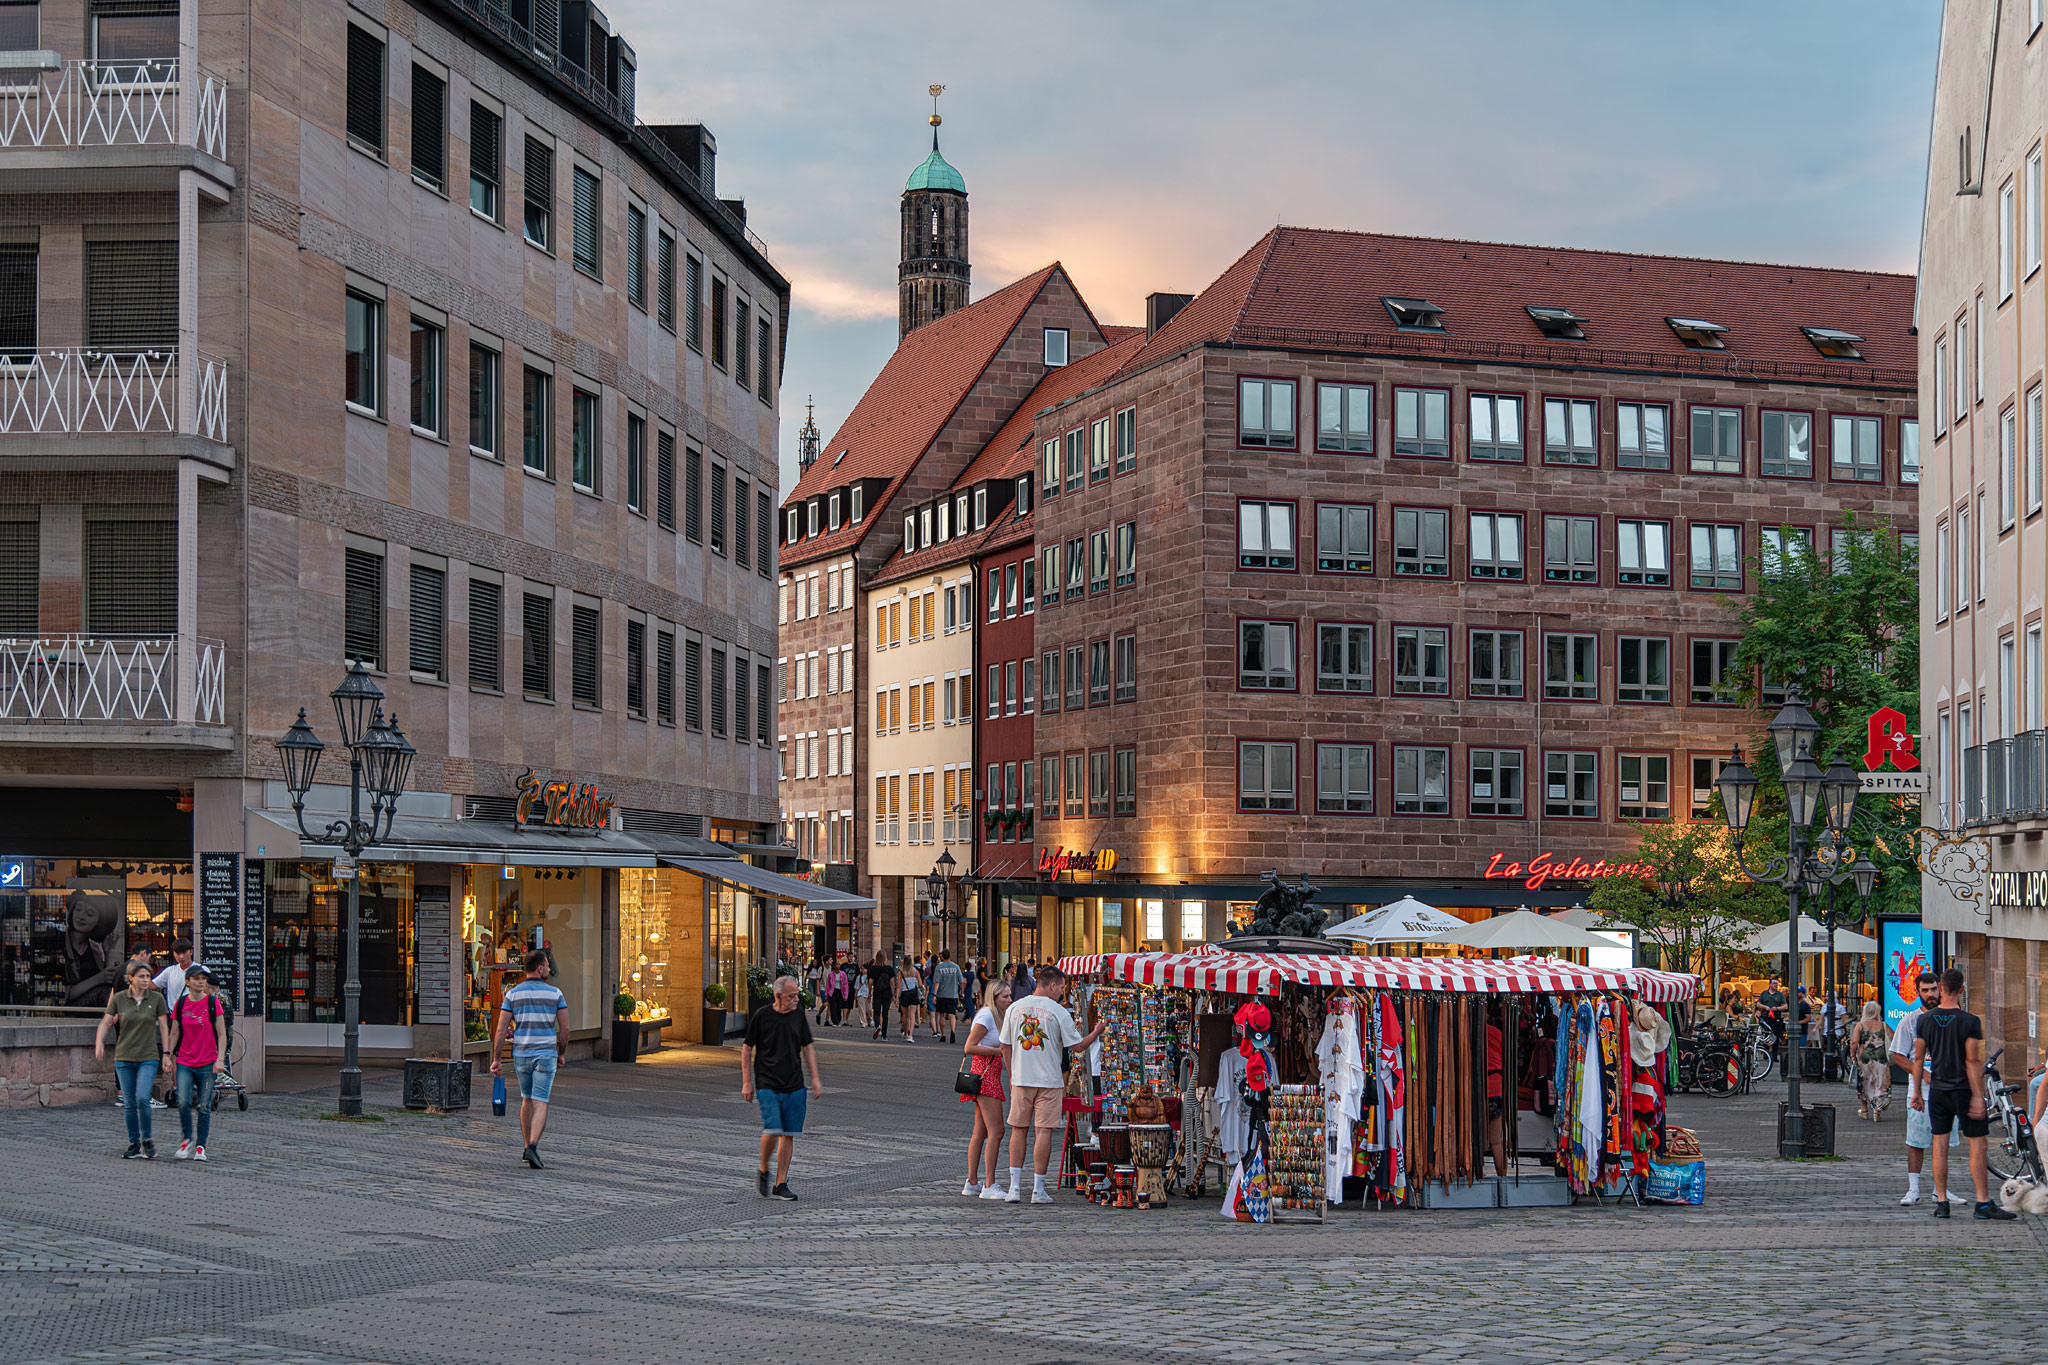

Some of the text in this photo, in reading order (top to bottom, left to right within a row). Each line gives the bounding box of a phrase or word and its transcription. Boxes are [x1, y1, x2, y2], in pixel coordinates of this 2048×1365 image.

[1866, 778, 1921, 788] SPITAL
[542, 780, 616, 828] Tchibo
[1038, 847, 1052, 872] La
[1483, 851, 1657, 890] La Gelateria
[1990, 871, 2048, 907] SPITAL APO
[1902, 936, 1914, 945] WE
